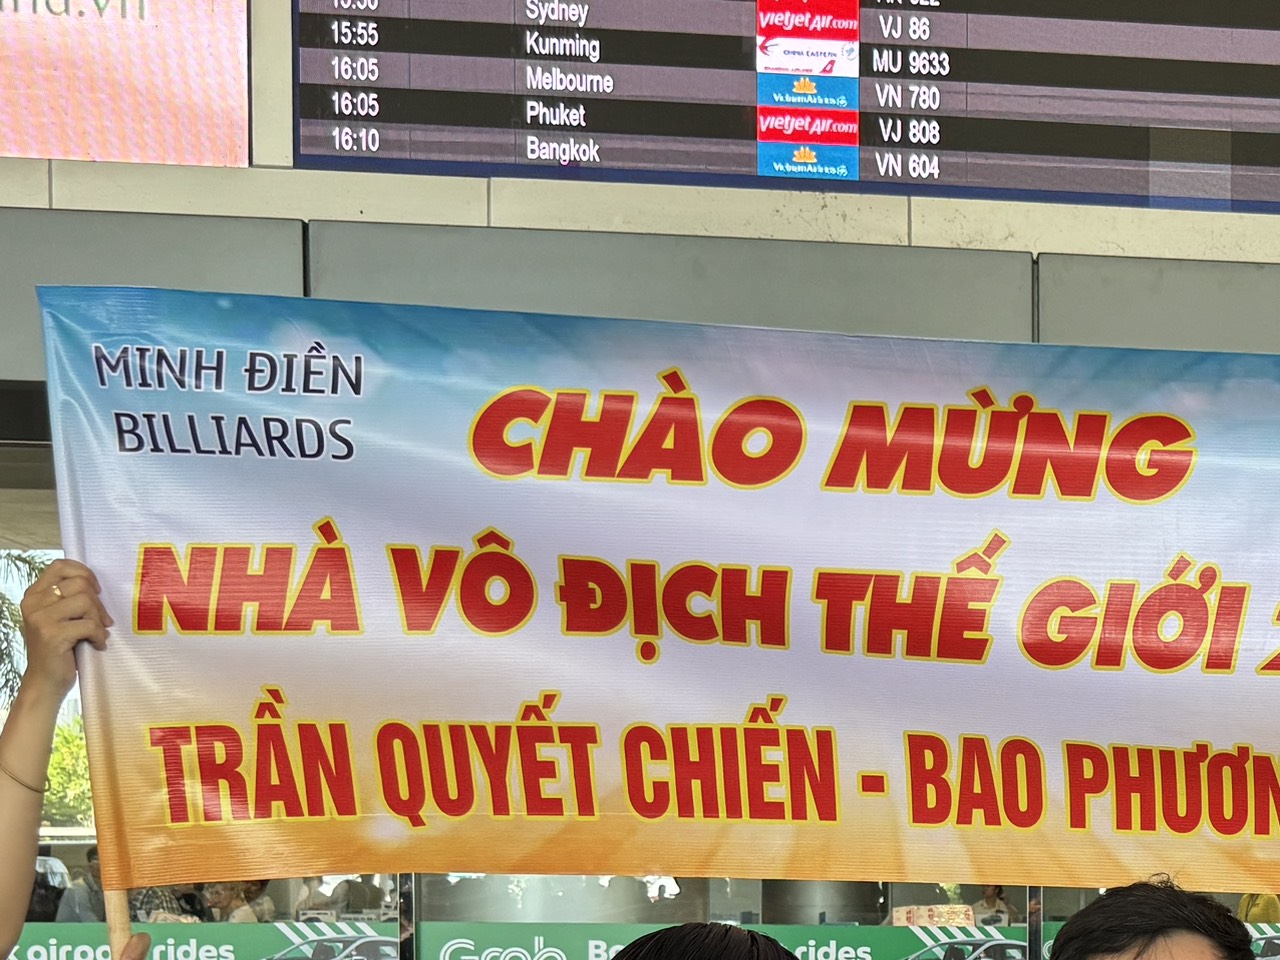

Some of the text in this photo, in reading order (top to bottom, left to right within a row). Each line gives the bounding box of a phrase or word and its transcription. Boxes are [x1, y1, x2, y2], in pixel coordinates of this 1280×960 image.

[525, 0, 589, 27] Sydney
[878, 14, 902, 39] VJ
[908, 16, 931, 41] 86
[331, 21, 601, 63] 15:55 Kunming
[331, 56, 614, 94] 16:05 Melbourne
[872, 48, 950, 76] MU 9633
[331, 91, 587, 127] 16:05 Phuket
[875, 84, 940, 110] VN 780
[331, 127, 601, 166] 16:10 Bangkok
[878, 117, 902, 143] VJ
[908, 119, 940, 144] 808
[875, 151, 940, 179] VN 604
[94, 341, 364, 398] MINH ĐIỀN
[114, 410, 356, 462] BILLIARDS
[469, 367, 1198, 505] CHÀO MỪNG
[131, 516, 367, 635] NHÀ
[385, 526, 539, 635] VÔ
[556, 553, 792, 665] ĐỊCH
[811, 528, 1011, 667] THẾ
[1017, 553, 1252, 674] GIỚI
[146, 684, 360, 827] TRẦN
[372, 689, 602, 828] QUYẾT
[619, 694, 841, 825] CHIẾN
[902, 730, 1048, 832] BAO
